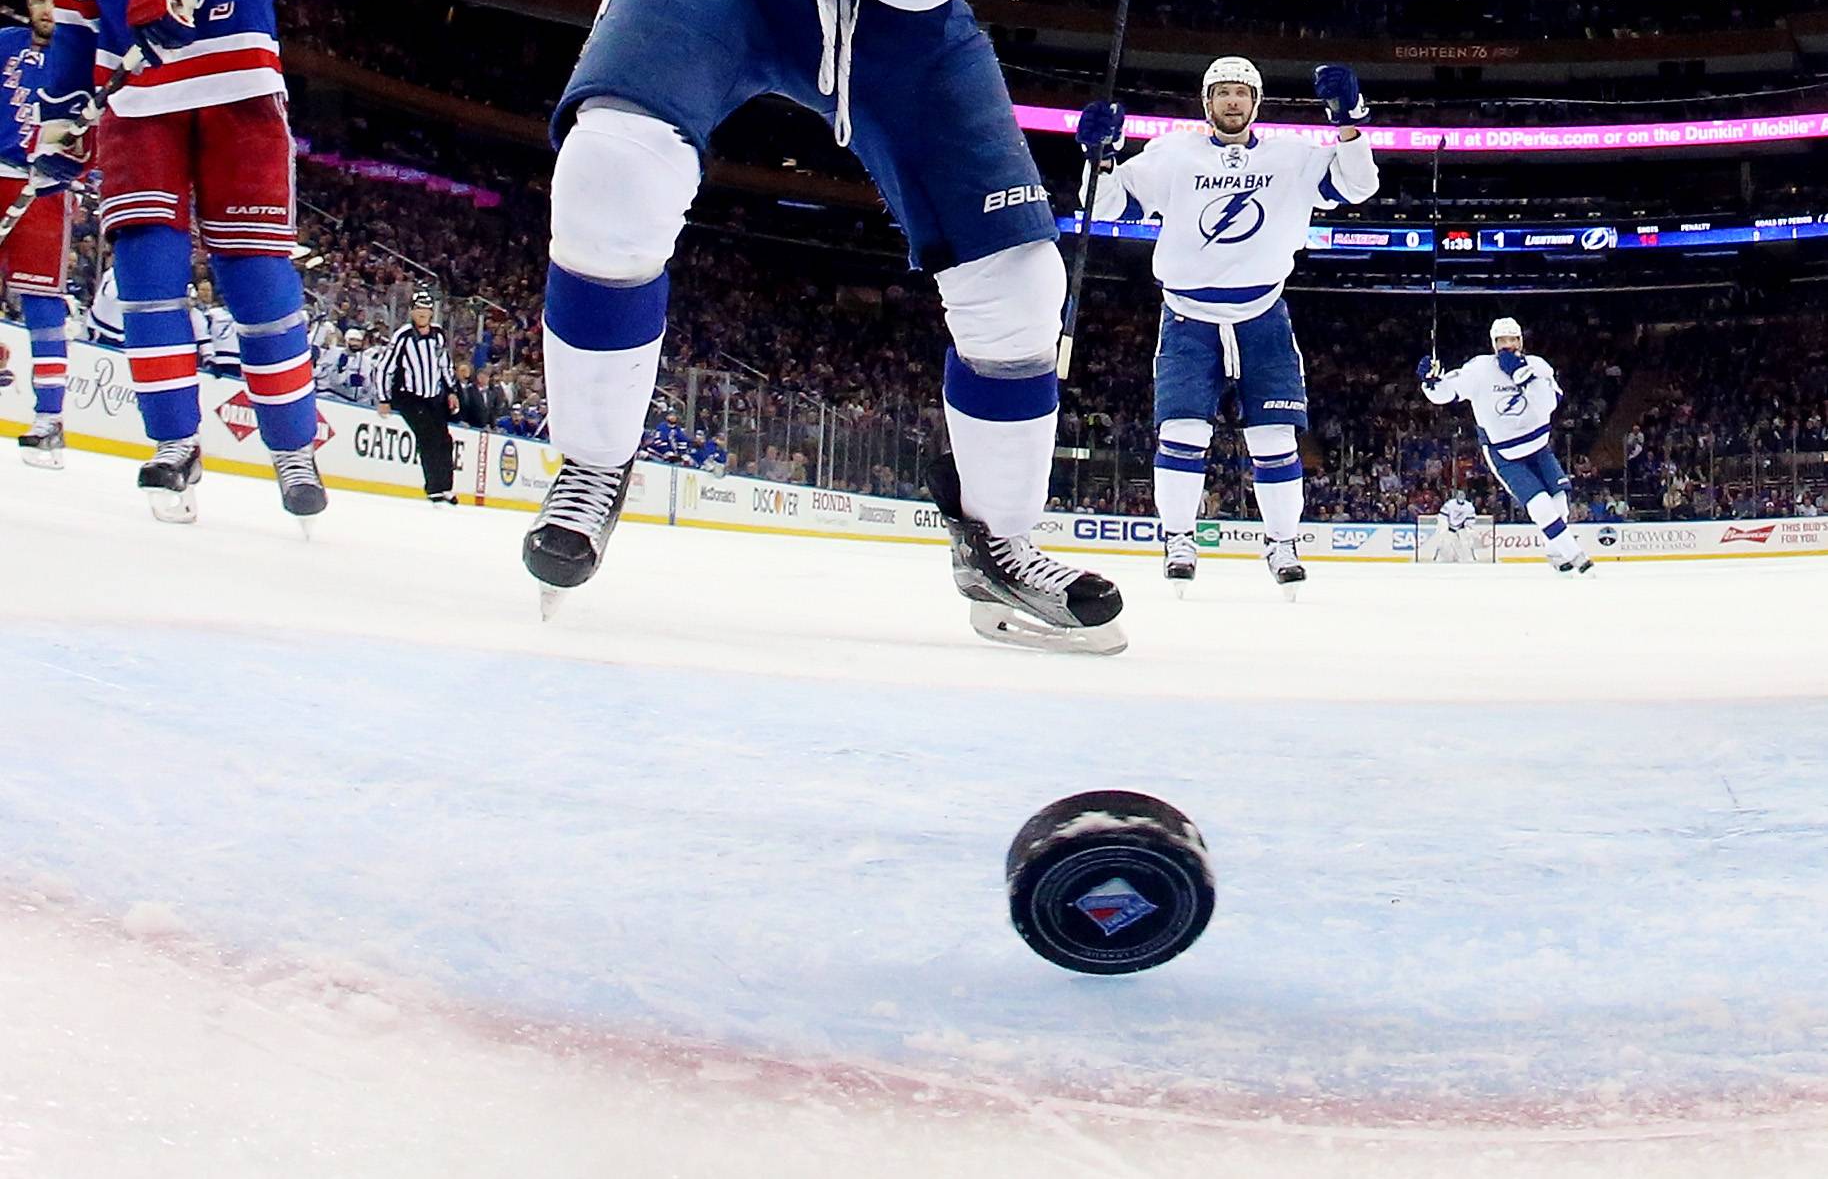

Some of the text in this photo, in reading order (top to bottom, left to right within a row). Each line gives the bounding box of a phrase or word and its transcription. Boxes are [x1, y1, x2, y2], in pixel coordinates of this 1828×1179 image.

[1395, 46, 1467, 58] EIGHTEEN
[1471, 45, 1488, 58] 76
[1464, 133, 1482, 146] at
[1486, 130, 1599, 146] DDPerks.com
[1603, 131, 1622, 145] or
[1627, 130, 1649, 144] on
[1653, 128, 1681, 143] the
[1685, 123, 1747, 141] Dunkin'
[1194, 174, 1274, 191] TAMPA BAY
[983, 184, 1051, 214] BAUE
[226, 205, 287, 216] EASTON
[1405, 231, 1420, 248] 0
[1493, 231, 1505, 248] 1
[74, 358, 139, 416] Roya
[752, 487, 799, 517] DISCOVER
[811, 492, 853, 513] HONDA
[1621, 529, 1697, 543] FOXWOODS
[1781, 523, 1801, 532] THIS
[1333, 528, 1370, 549] SAP
[1781, 534, 1798, 544] FOR
